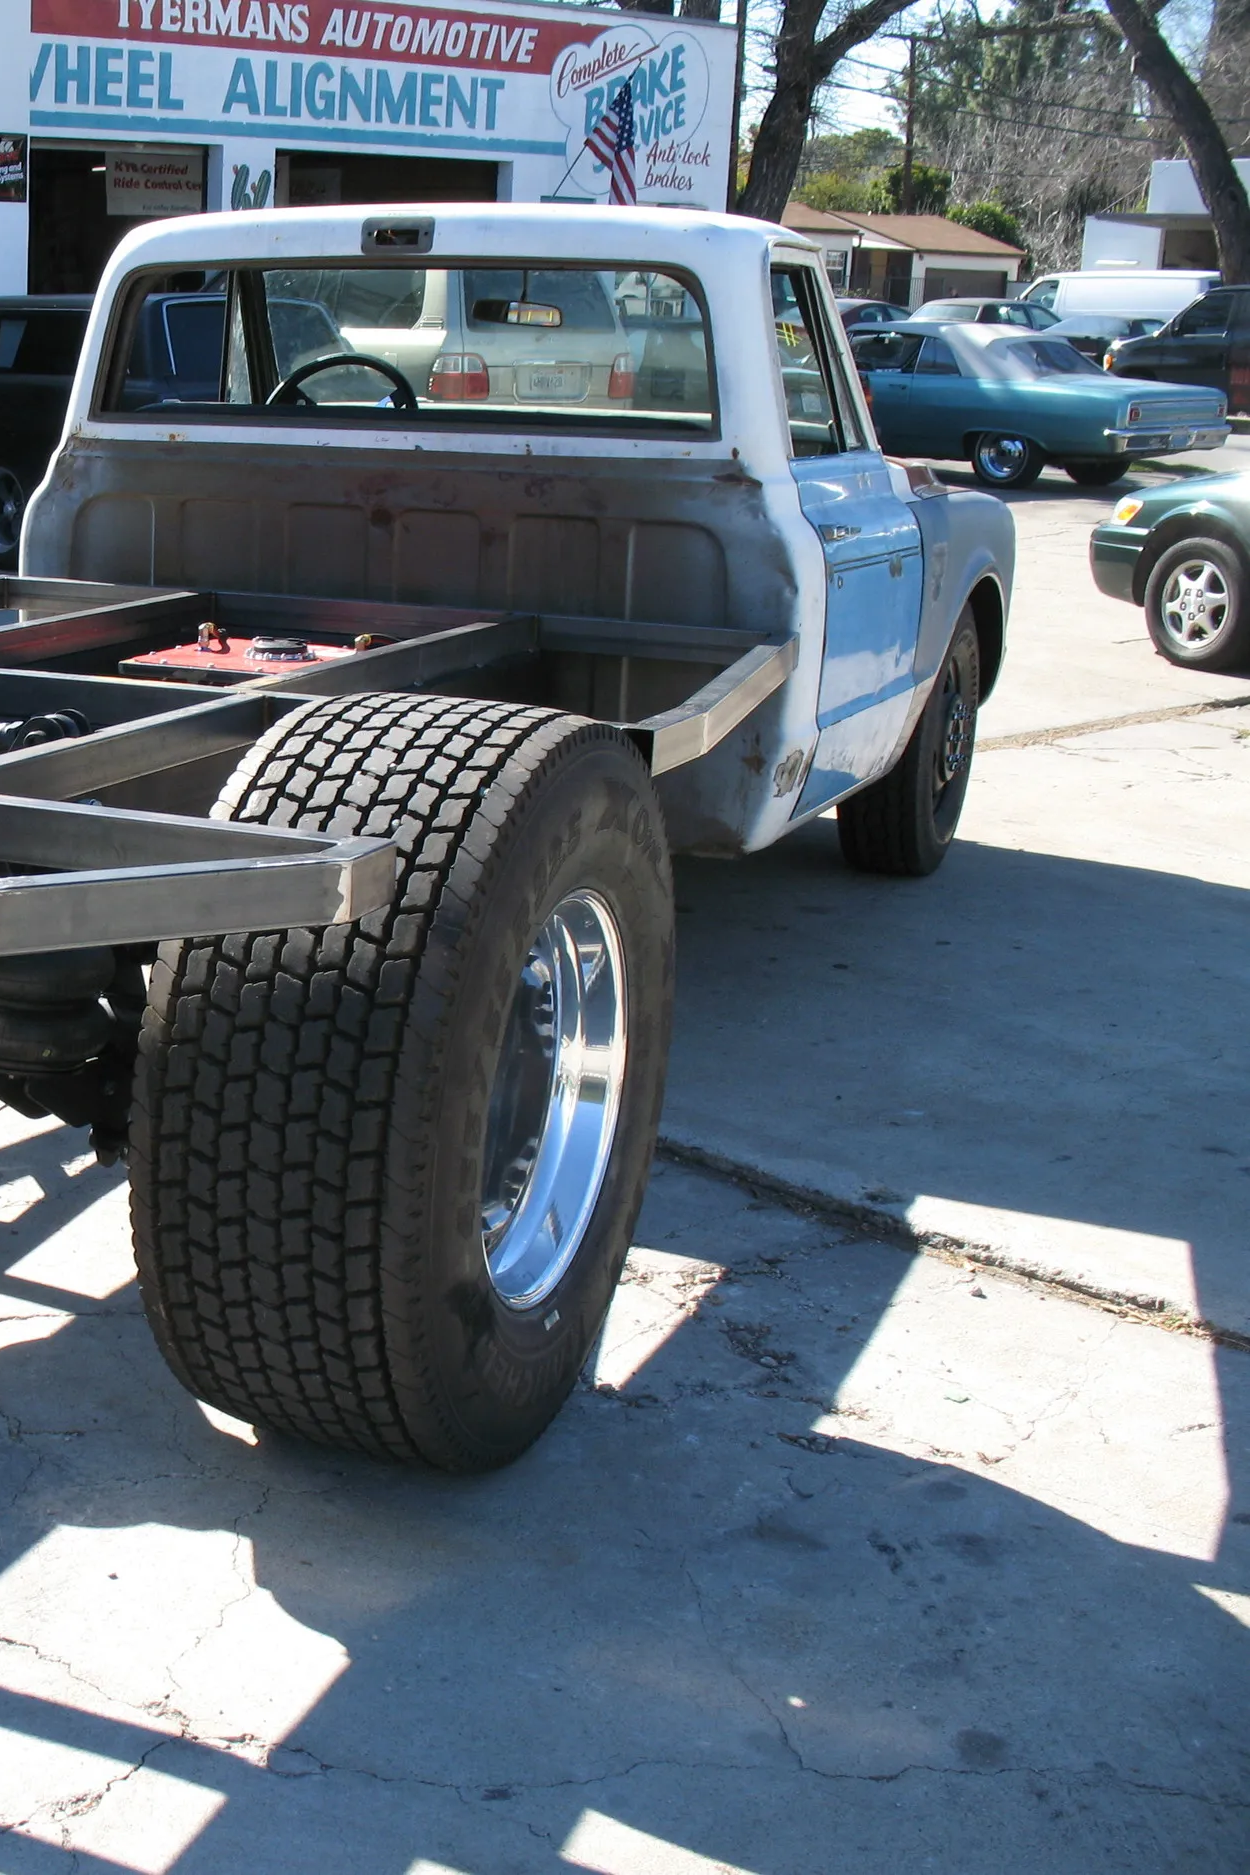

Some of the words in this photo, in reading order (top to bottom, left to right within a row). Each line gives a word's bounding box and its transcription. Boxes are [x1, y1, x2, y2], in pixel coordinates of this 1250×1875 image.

[320, 8, 539, 63] AUTOMOTIVE
[557, 41, 641, 98] Complete
[221, 57, 506, 131] ALIGNMENT
[8, 161, 22, 172] and
[140, 163, 189, 175] Certified
[644, 165, 694, 191] brakes
[113, 176, 141, 189] Ride
[144, 178, 183, 190] Control
